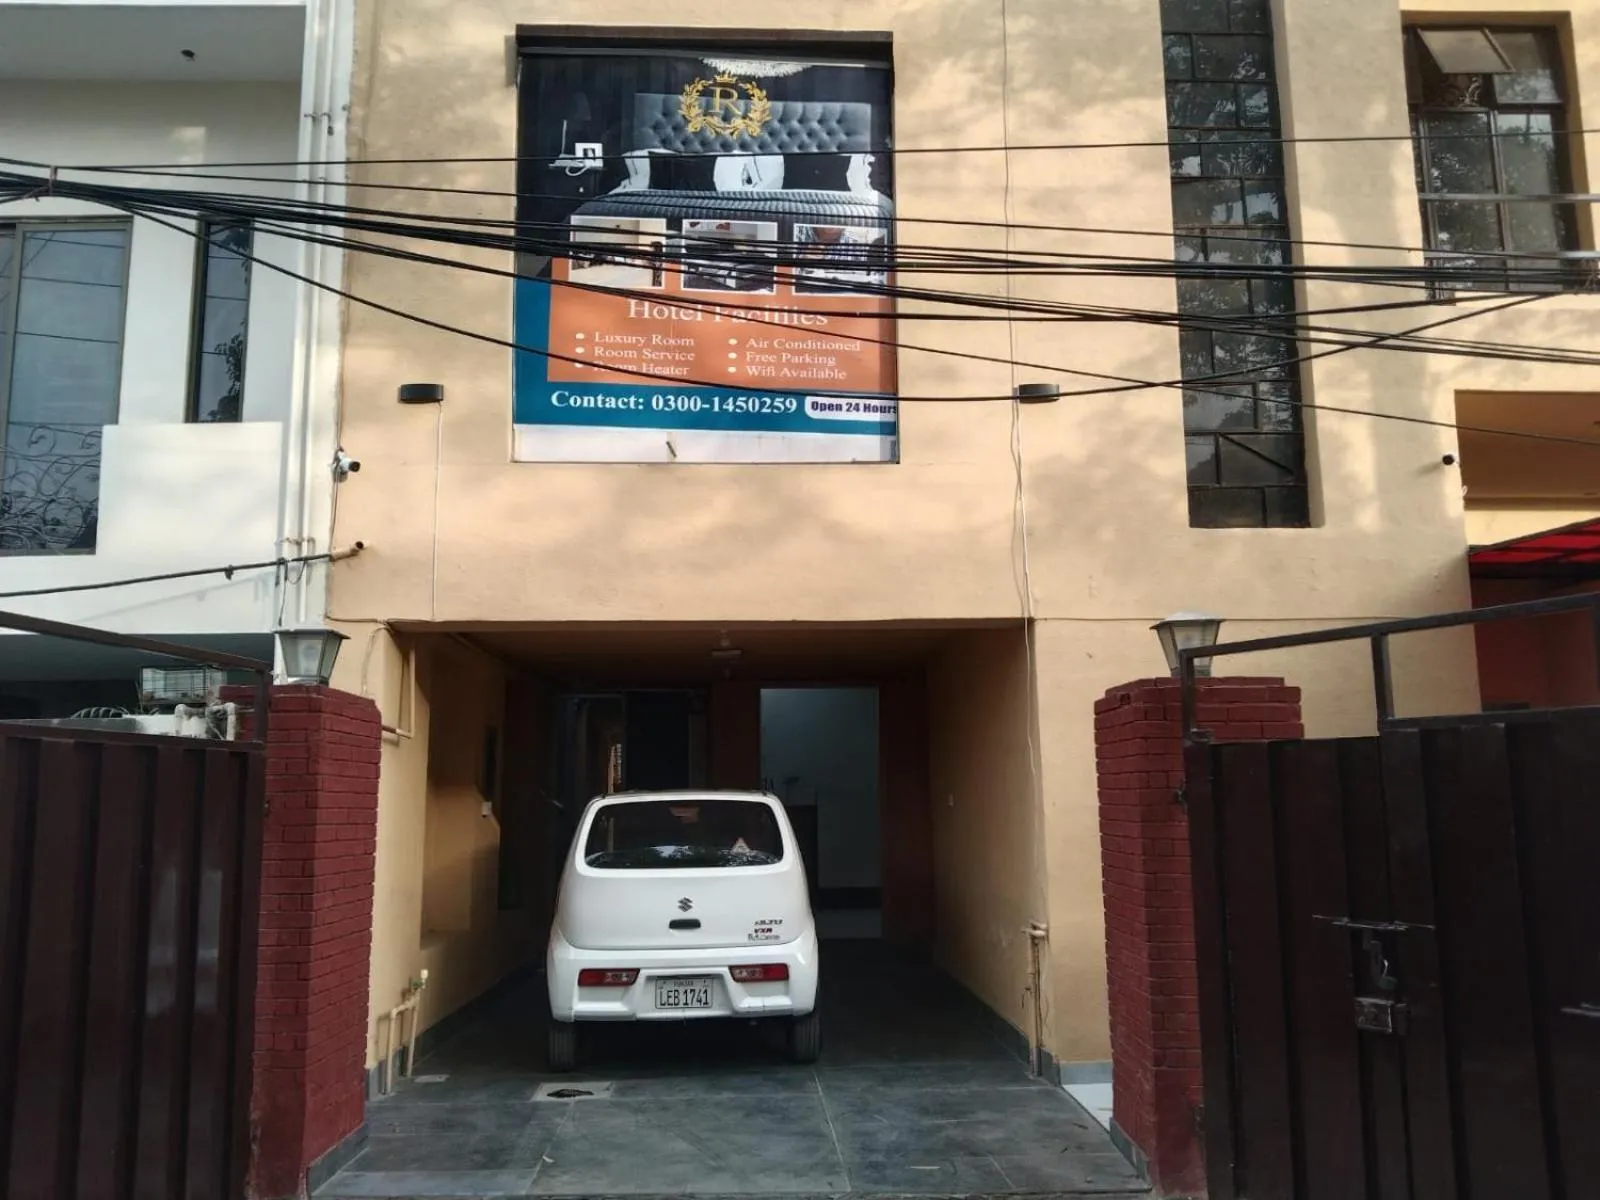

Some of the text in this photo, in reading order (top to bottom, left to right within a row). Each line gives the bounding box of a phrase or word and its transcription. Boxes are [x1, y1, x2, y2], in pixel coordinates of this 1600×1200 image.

[709, 86, 742, 115] R
[627, 299, 704, 321] Hotel
[594, 331, 696, 347] Luxury Room
[746, 338, 861, 352] Air Conditioned
[594, 346, 696, 361] Room Service
[746, 351, 837, 367] Free Parking
[642, 363, 690, 376] Heater
[746, 365, 848, 381] Wifi Available
[551, 390, 798, 413] Contact: 0300-1450259
[811, 400, 843, 412] Open
[846, 402, 861, 413] 24
[660, 988, 709, 1006] LEB 1741
